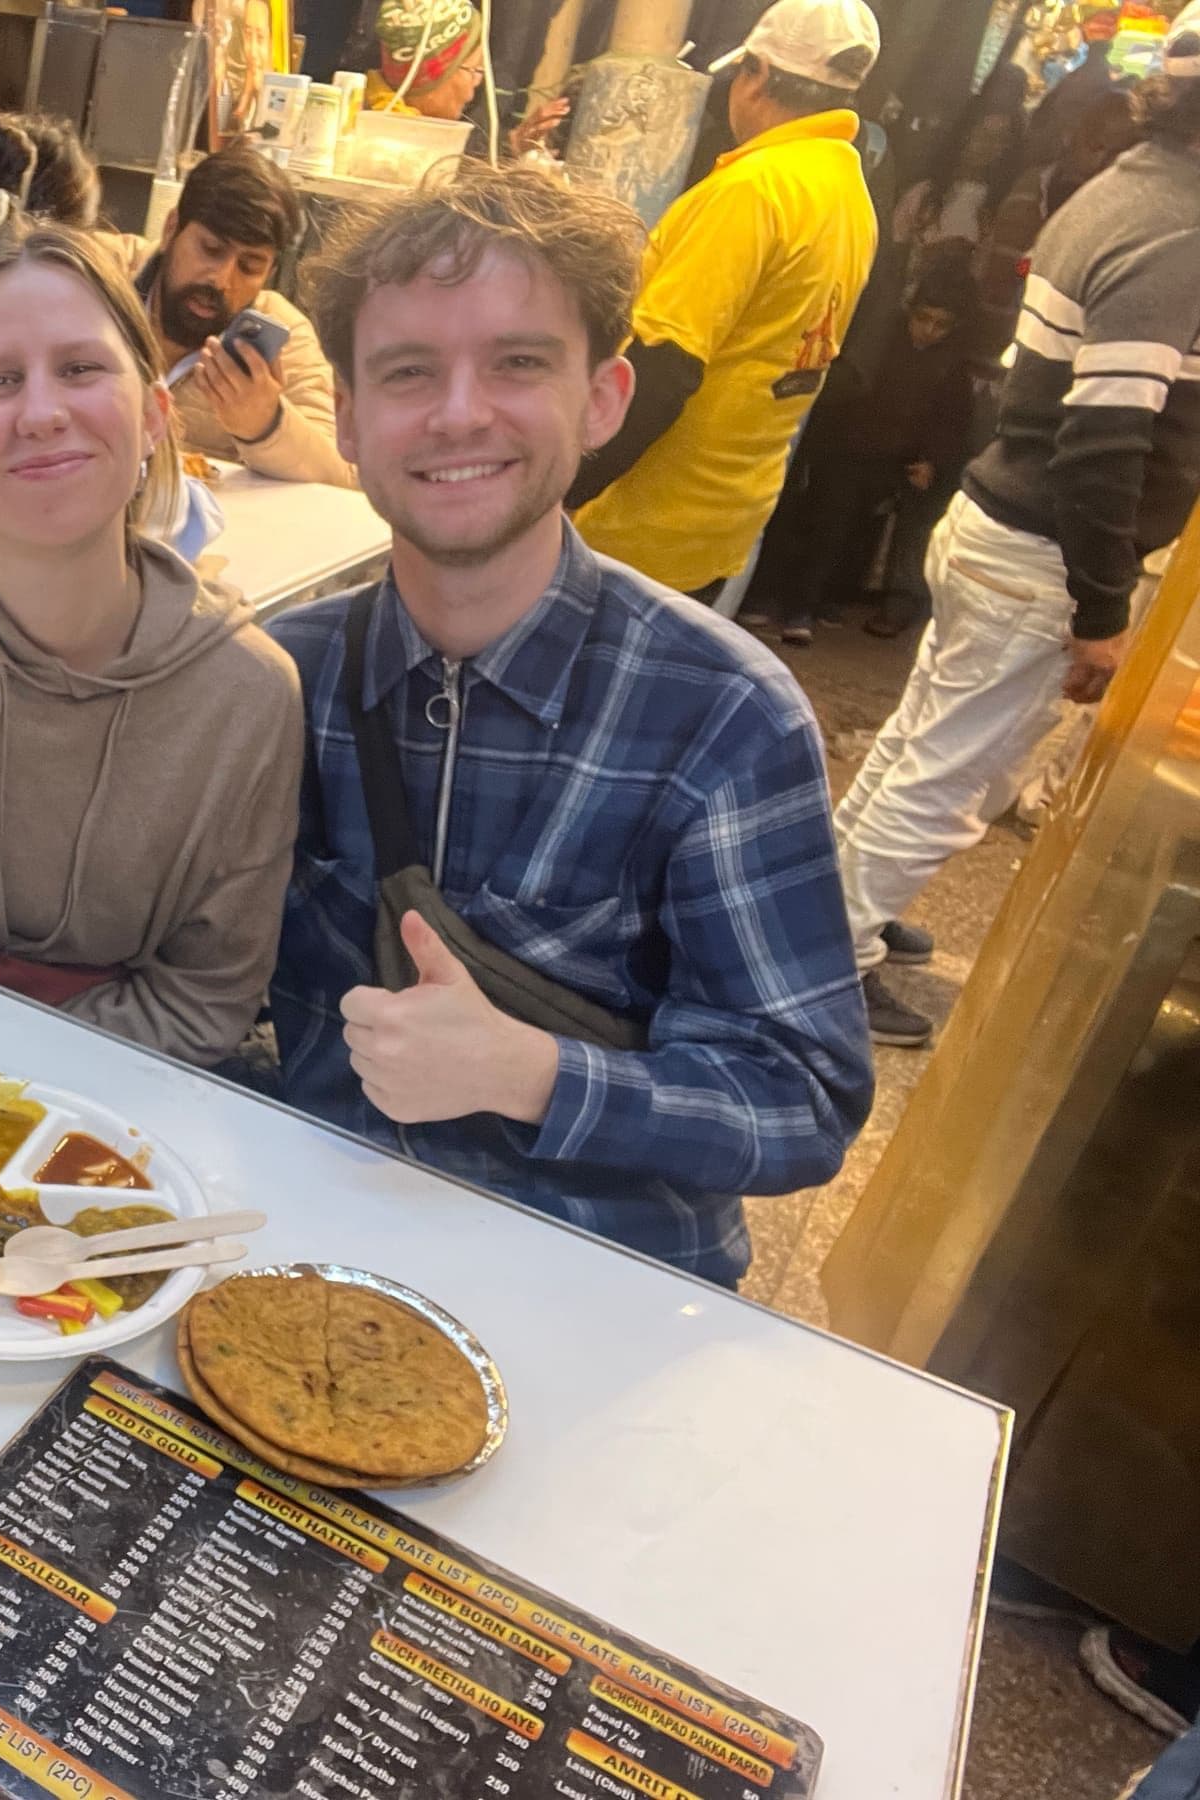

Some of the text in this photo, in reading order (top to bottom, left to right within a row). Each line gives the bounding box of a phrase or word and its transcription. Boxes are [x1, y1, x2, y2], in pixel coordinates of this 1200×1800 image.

[105, 1408, 198, 1465] OLD IS GOLD
[255, 1490, 365, 1560] KUCH HATTKE
[108, 1570, 130, 1587] 200
[113, 1384, 141, 1404] ONE
[142, 1399, 184, 1427] PLATE
[190, 1424, 225, 1450] RATE
[308, 1488, 340, 1512] ONE
[340, 1507, 388, 1540] PLATE
[394, 1536, 434, 1566] RATE
[436, 1560, 472, 1584] LIST
[476, 1582, 519, 1614] (2PC)
[530, 1611, 566, 1638] ONE
[569, 1631, 620, 1669] PLATE
[628, 1664, 673, 1696] RATE
[676, 1690, 714, 1717] LIST
[720, 1715, 768, 1750] (2PC)
[99, 1582, 121, 1599] 200
[64, 1627, 87, 1645] 250
[74, 1615, 96, 1632] 250
[419, 1581, 555, 1663] NEW BORN BABY
[54, 1640, 77, 1658] 250
[463, 1628, 504, 1656] Paratha
[35, 1666, 58, 1685] 300
[44, 1653, 68, 1672] 250
[175, 1645, 215, 1675] Paratha
[292, 1663, 315, 1681] 250
[24, 1680, 47, 1698] 300
[377, 1634, 536, 1735] KUCH MEETHA HO JAYE
[14, 1693, 37, 1713] 300
[111, 1662, 149, 1690] Paneer
[242, 1745, 266, 1764] 300
[83, 1703, 139, 1745] Hara Bhara
[103, 1675, 141, 1704] Haryali
[233, 1759, 258, 1779] 300
[259, 1716, 283, 1736] 300
[587, 1703, 623, 1729] Papad
[622, 1722, 640, 1740] Fry
[650, 1708, 688, 1737] PAPAD
[688, 1730, 726, 1760] PAKKA
[63, 1731, 92, 1756] Sattu
[73, 1717, 139, 1765] Palak Paneer
[94, 1690, 249, 1794] Chatpata Mango 400
[251, 1730, 275, 1750] 300
[371, 1735, 392, 1754] Dry
[390, 1746, 417, 1769] Fruit
[378, 1711, 420, 1741] Banana
[485, 1775, 510, 1794] 250
[420, 1708, 470, 1744] (Jaggery)
[495, 1752, 520, 1772] 200
[505, 1730, 529, 1749] 200
[7, 1732, 46, 1762] LIST
[46, 1760, 92, 1799] (2PC)
[309, 1756, 360, 1794] Khurchan
[321, 1734, 396, 1786] Rabdi Paratha
[565, 1756, 596, 1780] Lassi
[604, 1754, 672, 1797] AMRIT
